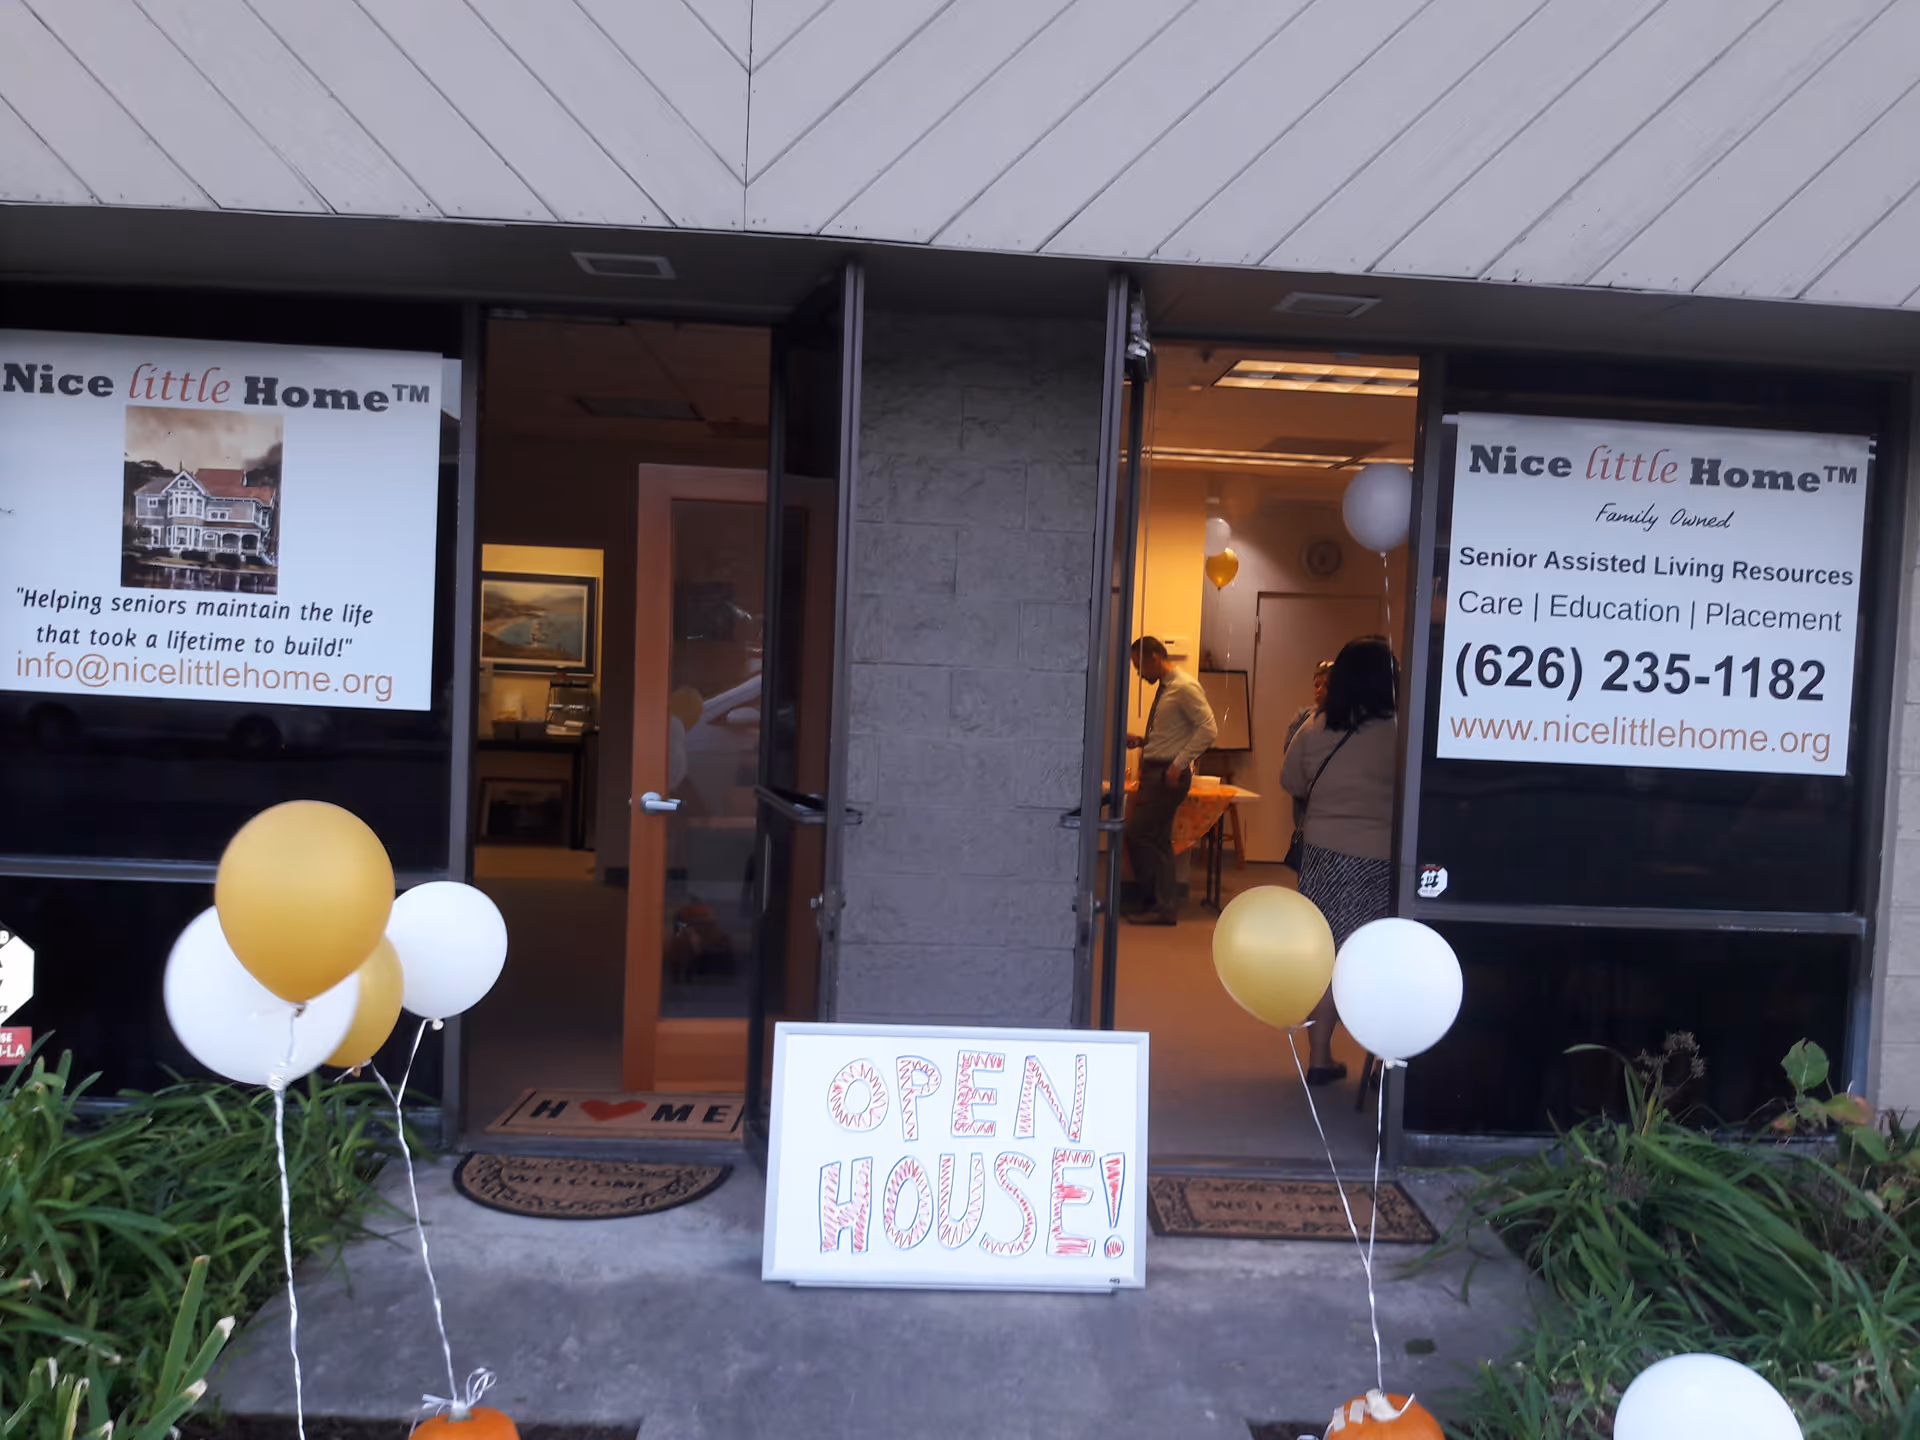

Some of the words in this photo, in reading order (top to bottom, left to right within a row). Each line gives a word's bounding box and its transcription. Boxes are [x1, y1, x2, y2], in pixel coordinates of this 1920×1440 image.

[3, 363, 113, 397] Nice
[128, 361, 232, 403] little
[1469, 445, 1572, 477] Nice
[1586, 444, 1678, 483] little
[1596, 503, 1658, 532] Family
[1670, 508, 1734, 528] Owned
[1460, 547, 1537, 568] Senior
[1544, 551, 1645, 573] Assisted
[1655, 557, 1723, 583] Living
[1733, 561, 1853, 585] Resources
[17, 587, 101, 614] "Helping
[111, 595, 186, 614] seniors
[196, 600, 289, 619] maintain
[301, 603, 333, 621] the
[343, 604, 373, 625] life
[1459, 591, 1522, 615] Care
[1551, 595, 1679, 622] Education
[1707, 603, 1842, 631] Placement
[37, 624, 80, 644] that
[91, 628, 136, 646] took
[146, 634, 157, 648] a
[168, 630, 245, 653] lifetime
[255, 638, 274, 653] to
[285, 636, 352, 657] build!"
[16, 649, 391, 701] info@nicelittlehome.org
[1456, 643, 1582, 701] (626)
[1601, 650, 1825, 701] 235-1182
[1449, 714, 1830, 762] www.nicelittlehome.org
[827, 1050, 1087, 1142] OPEN
[819, 1147, 1125, 1258] HOUSE!
